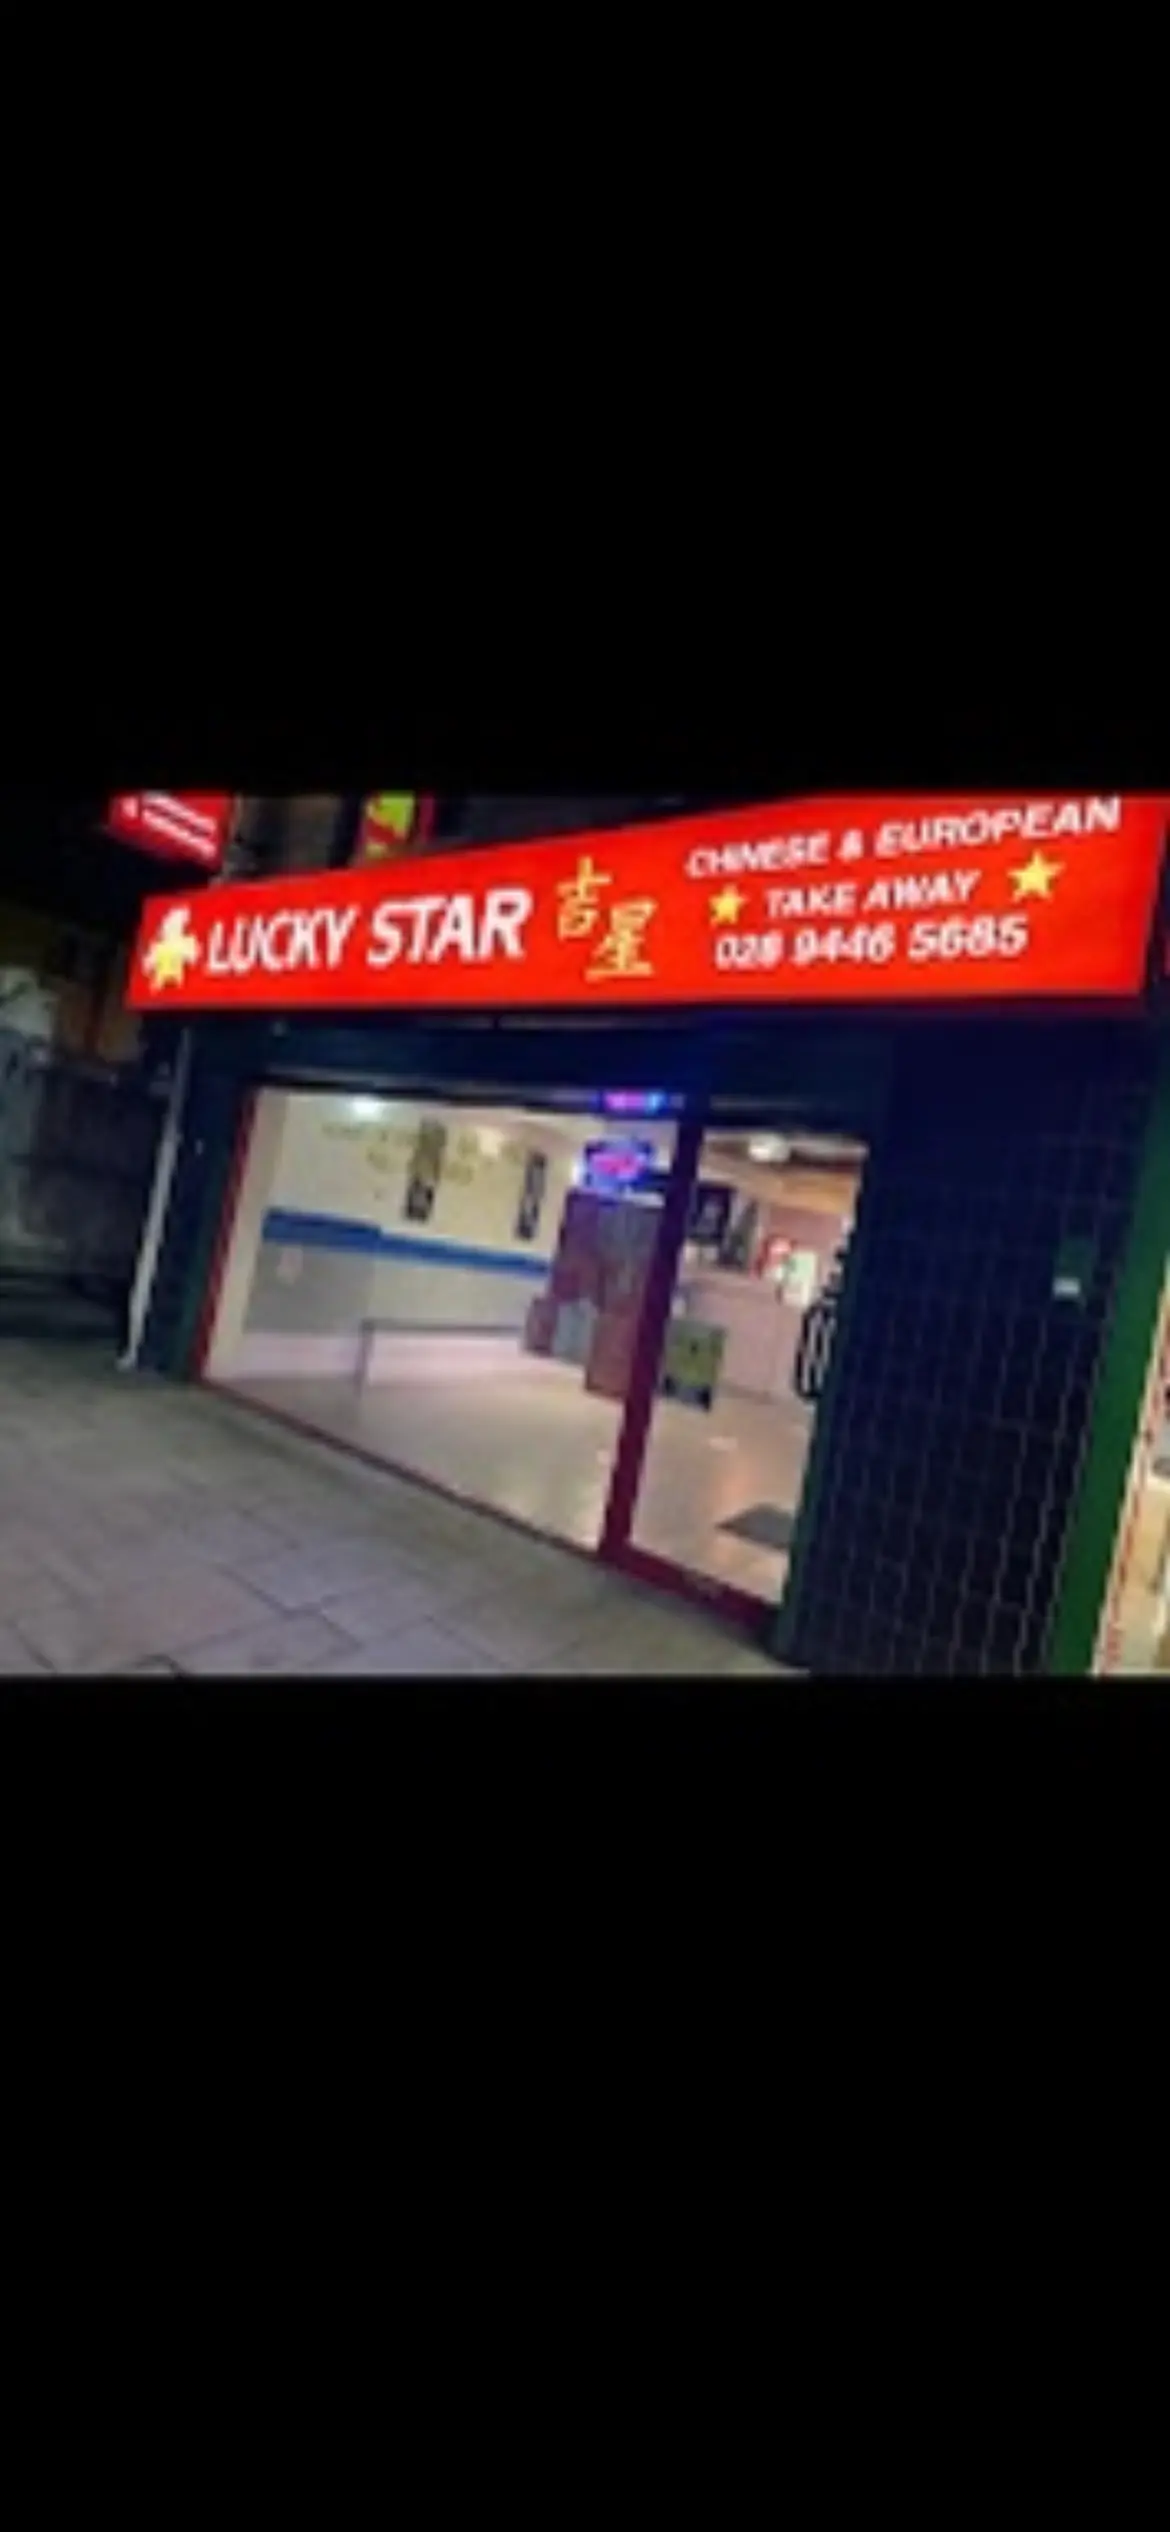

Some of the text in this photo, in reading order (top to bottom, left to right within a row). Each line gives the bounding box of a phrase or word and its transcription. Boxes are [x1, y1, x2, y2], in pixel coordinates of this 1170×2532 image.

[686, 794, 1122, 877] CHINESE & EUROPEAN
[765, 868, 980, 919] TAKE AWAY
[207, 889, 532, 973] LUCKY STAR
[715, 913, 1028, 968] 028 9446 5685
